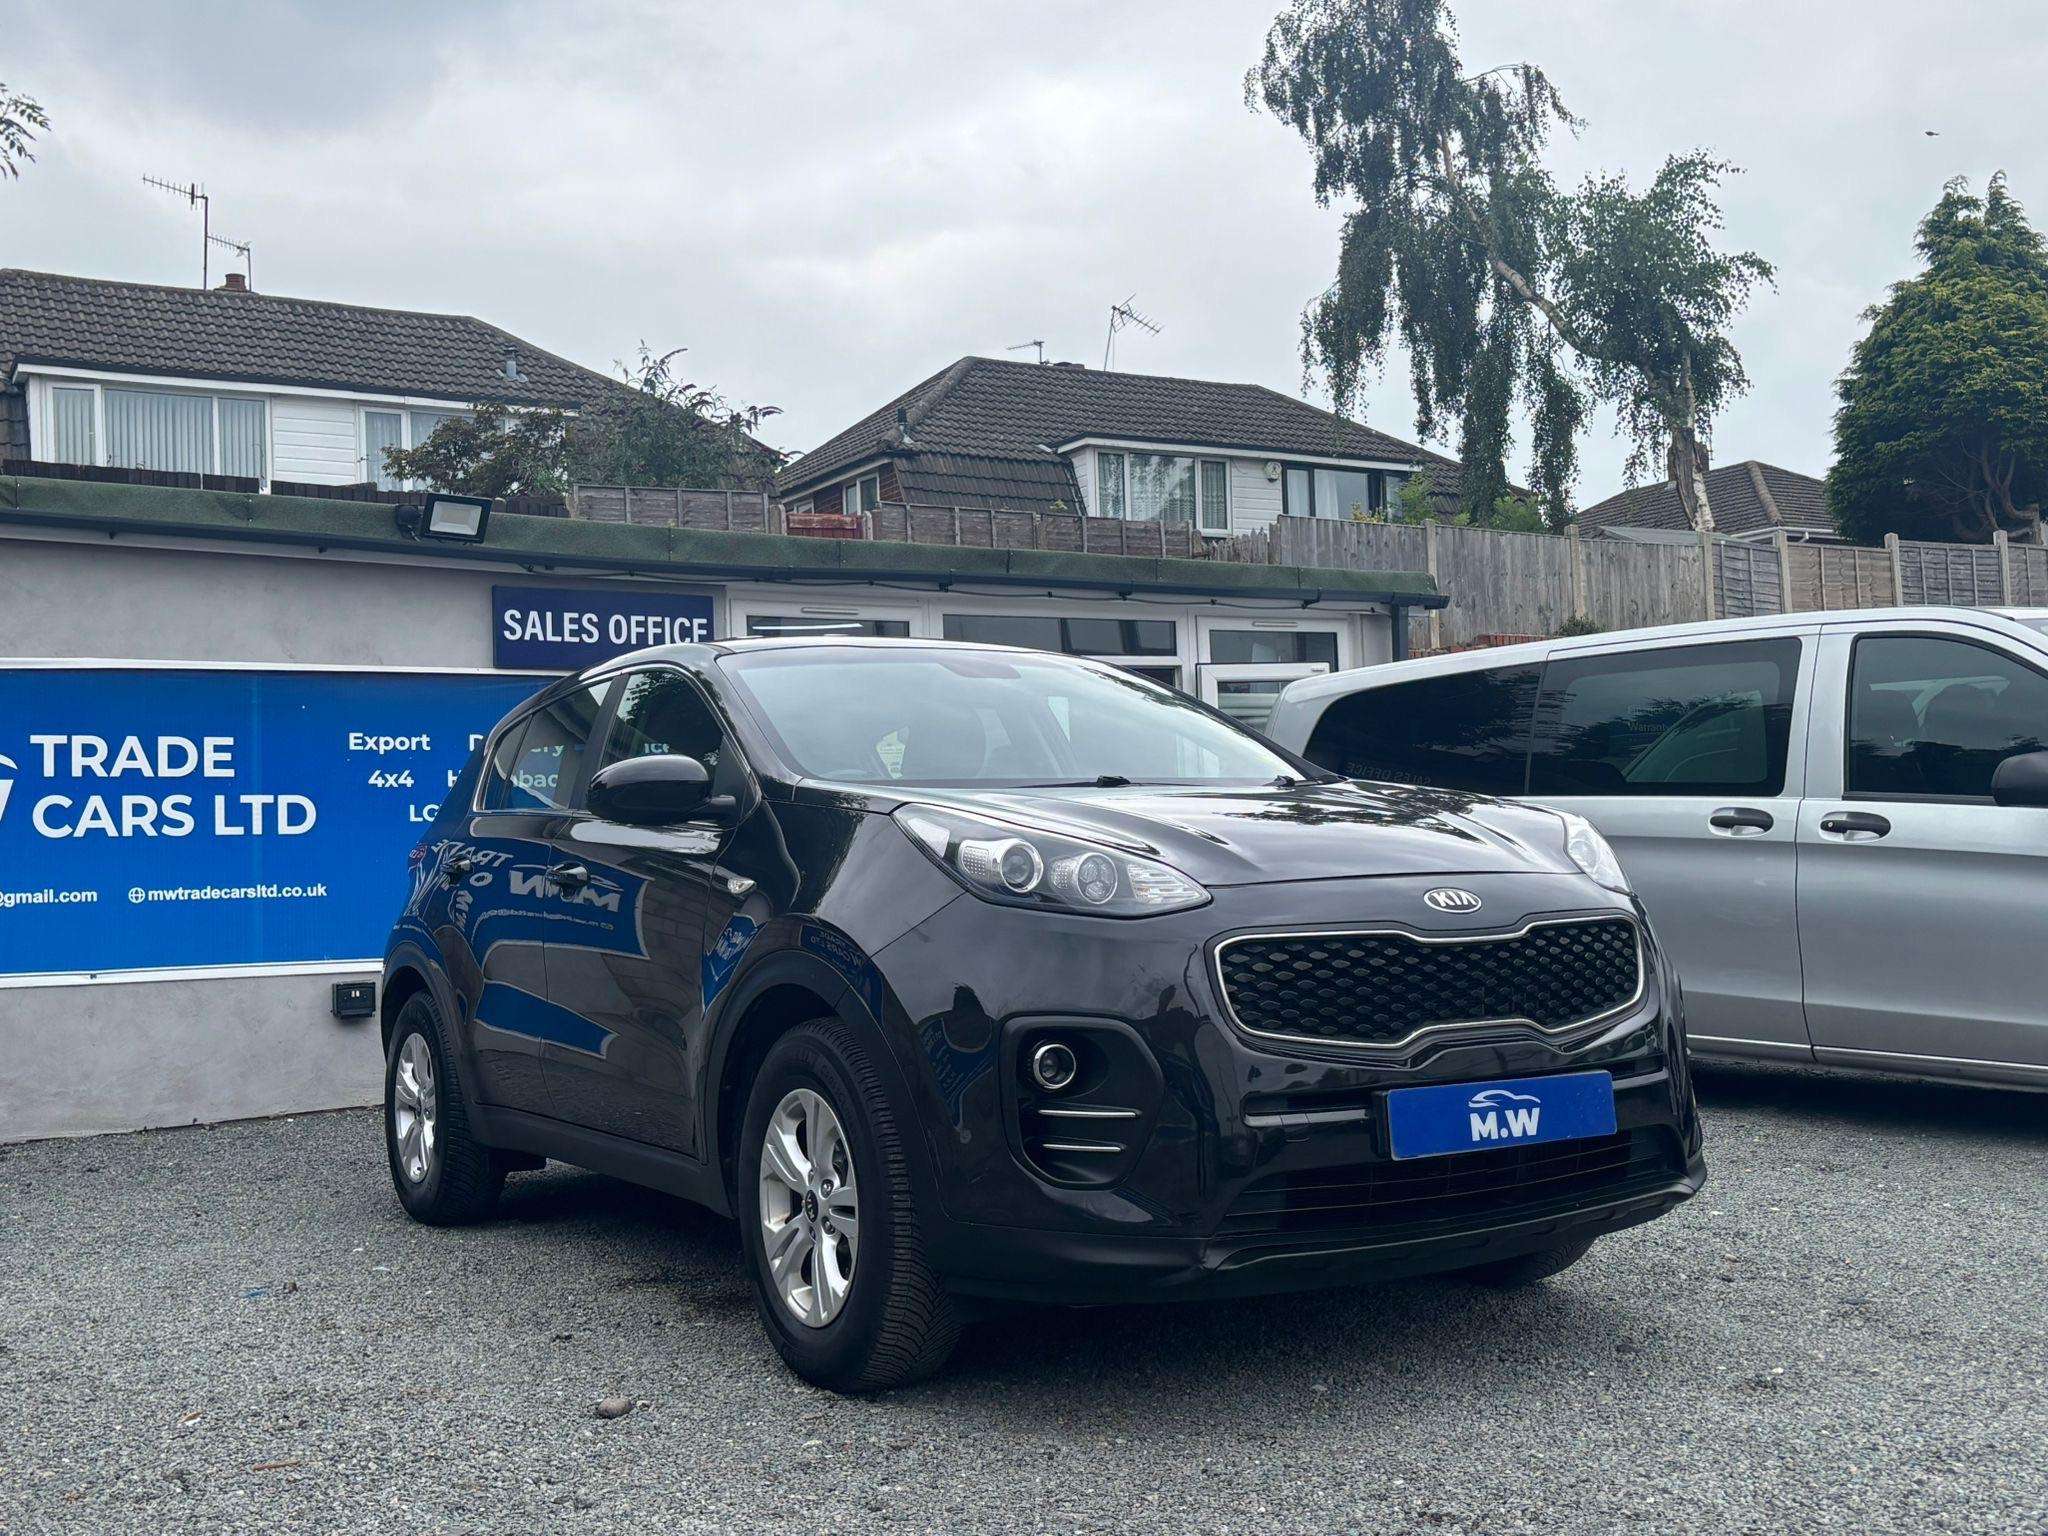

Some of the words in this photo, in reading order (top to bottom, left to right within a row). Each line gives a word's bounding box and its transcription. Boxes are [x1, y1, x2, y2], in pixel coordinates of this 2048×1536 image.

[503, 609, 600, 644] SALES
[608, 614, 708, 645] OFFICE
[348, 732, 431, 755] Export
[30, 734, 235, 778] TRADE
[368, 769, 415, 788] 4x4
[32, 794, 195, 838] CARS
[214, 794, 317, 836] LTD
[0, 889, 98, 908] gmail.com
[148, 883, 328, 902] mwtradecarsltd.co.uk
[1432, 888, 1478, 908] KIA
[1469, 1107, 1541, 1142] M.W
